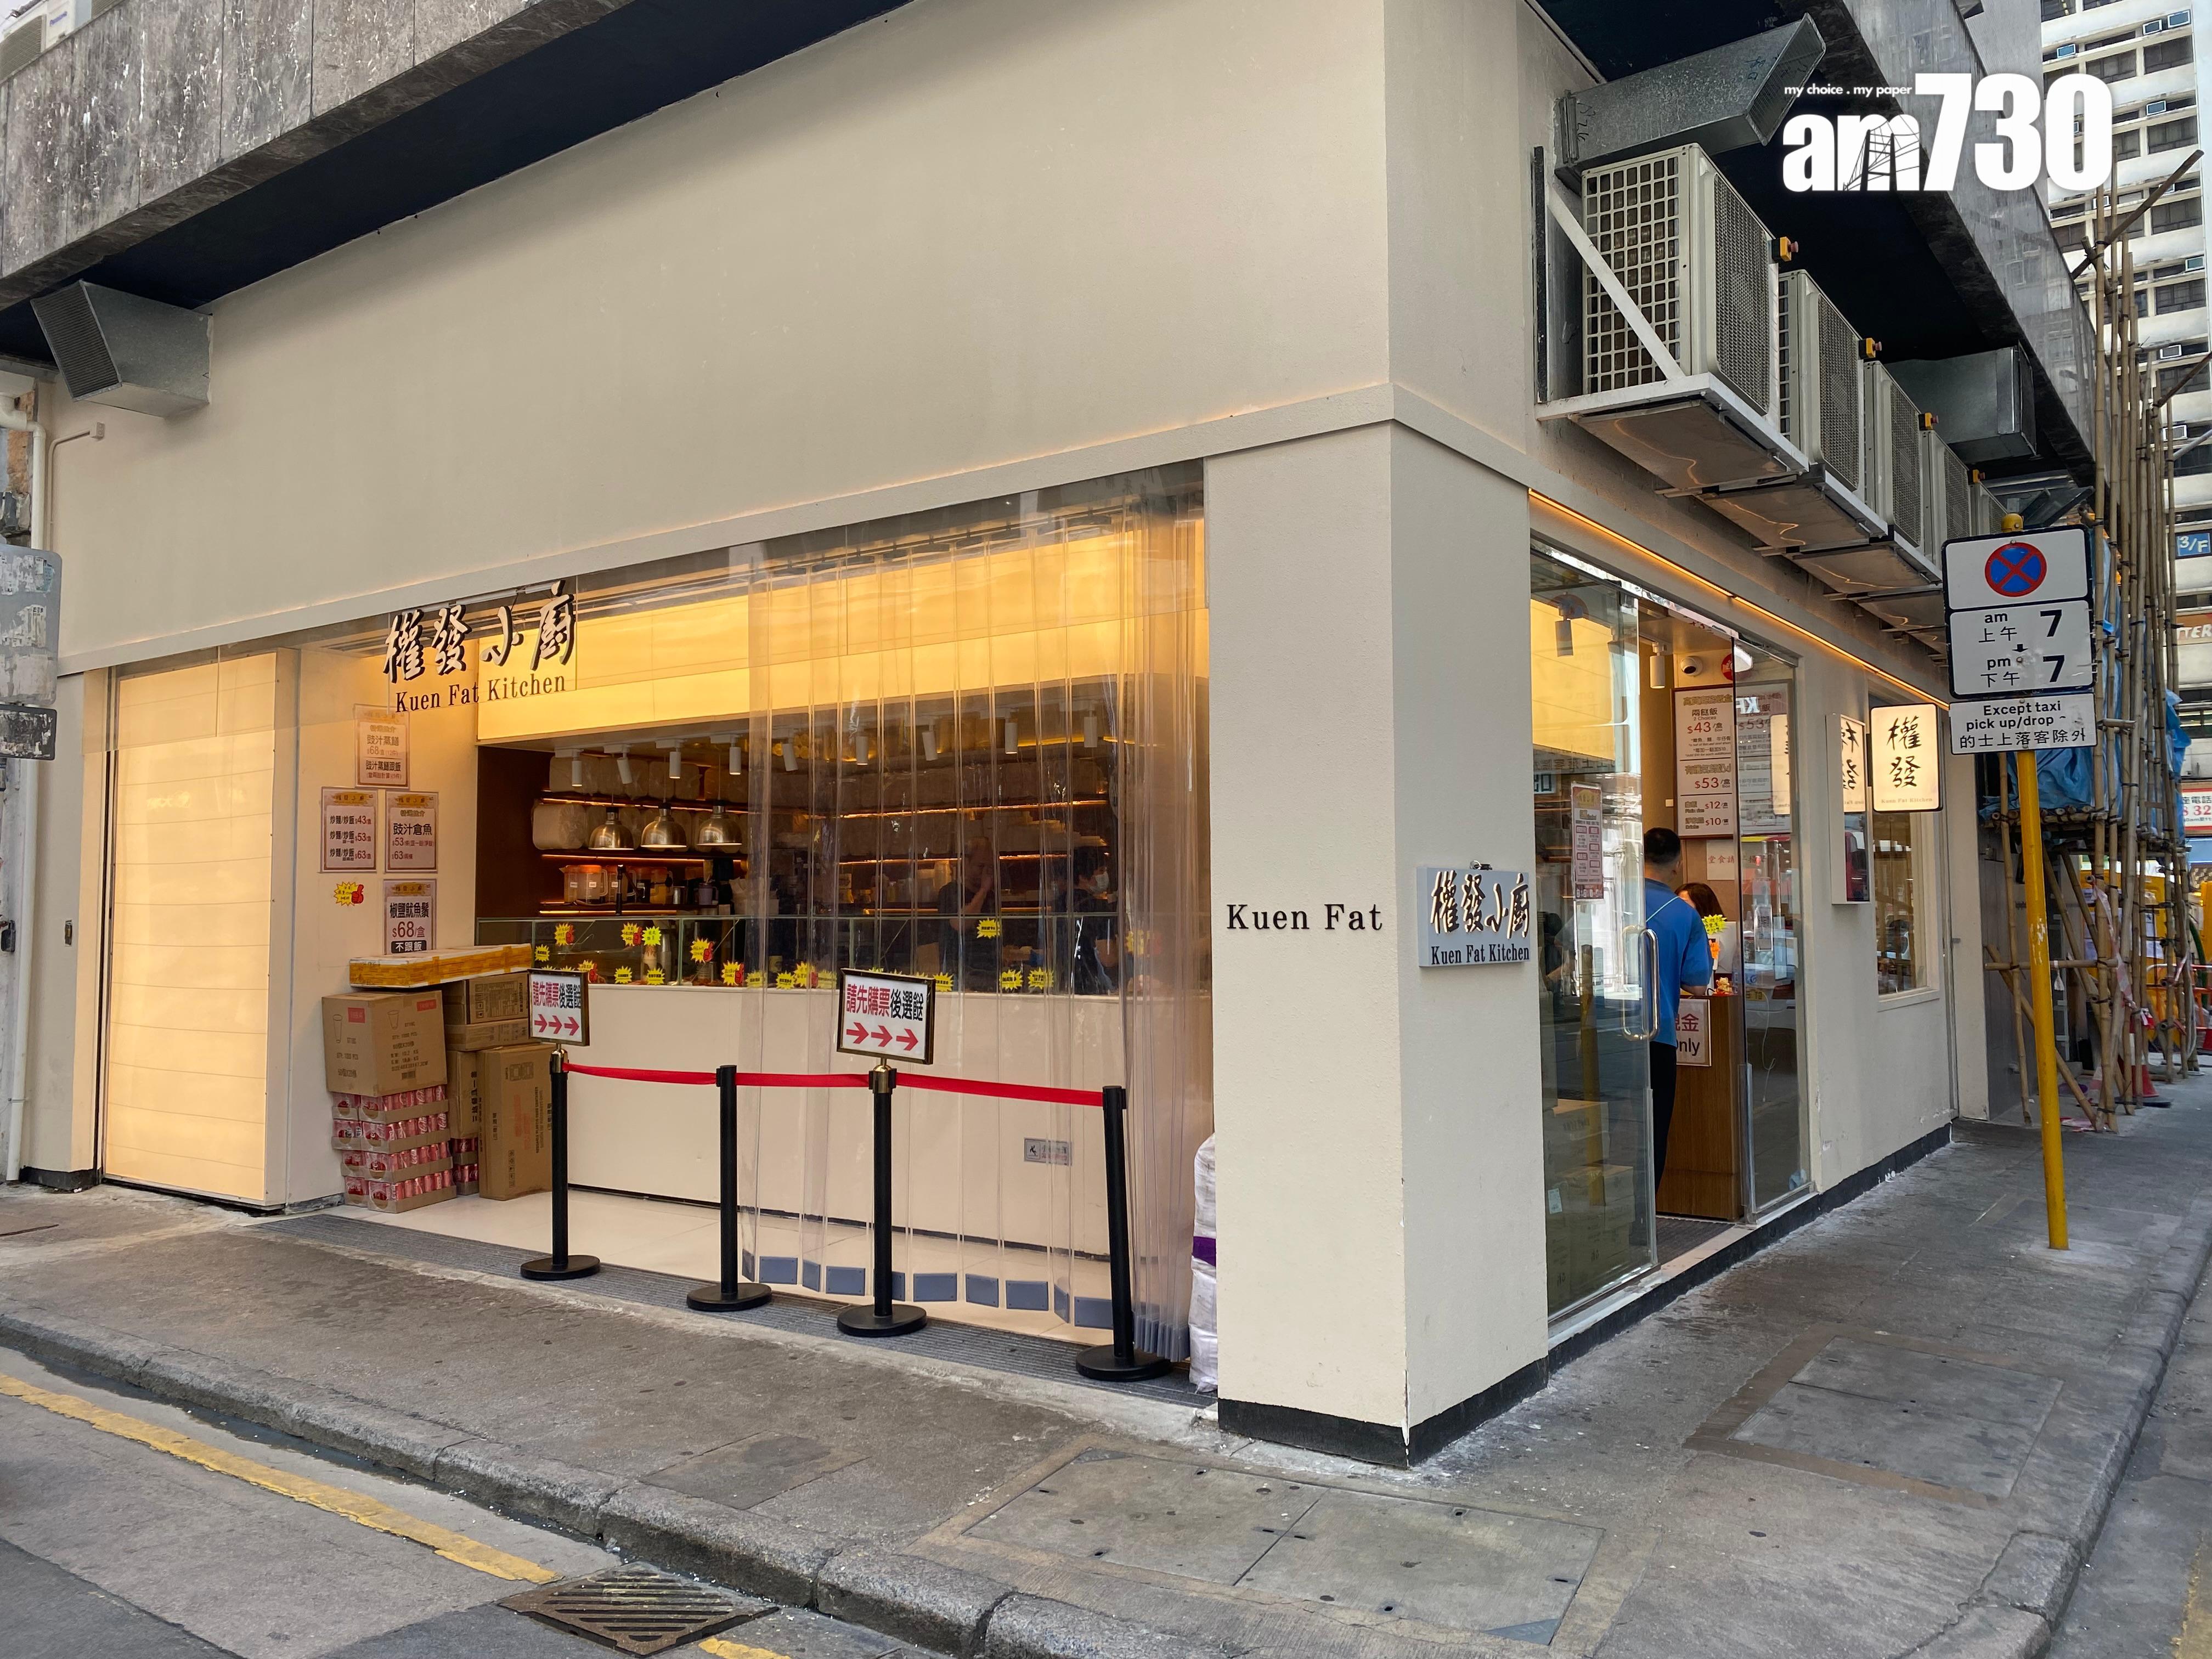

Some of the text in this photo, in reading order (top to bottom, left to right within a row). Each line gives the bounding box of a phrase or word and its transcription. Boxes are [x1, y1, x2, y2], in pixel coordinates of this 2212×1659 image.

[2180, 535, 2208, 552] 3/F
[383, 580, 576, 684] 權發小廚
[1984, 609, 2063, 637] am 7
[1978, 626, 2017, 643] 上午
[1987, 654, 2065, 683] pm 7
[1980, 672, 2020, 688] 下午
[396, 673, 566, 713] Kuen Fat Kitchen
[1983, 701, 2061, 716] Except taxi
[1966, 716, 2054, 732] pick up/drop
[1960, 727, 2086, 749] 的士上落客除外
[1887, 715, 1922, 788] 權發
[393, 823, 432, 835] 豉汁倉魚
[1430, 870, 1530, 939] 權發小廚
[1227, 903, 1383, 930] Kuen Fat
[1431, 943, 1530, 965] Kuen Fat Kitchen
[847, 984, 924, 1021] 請先購票後選餸
[1676, 1037, 1700, 1056] nly
